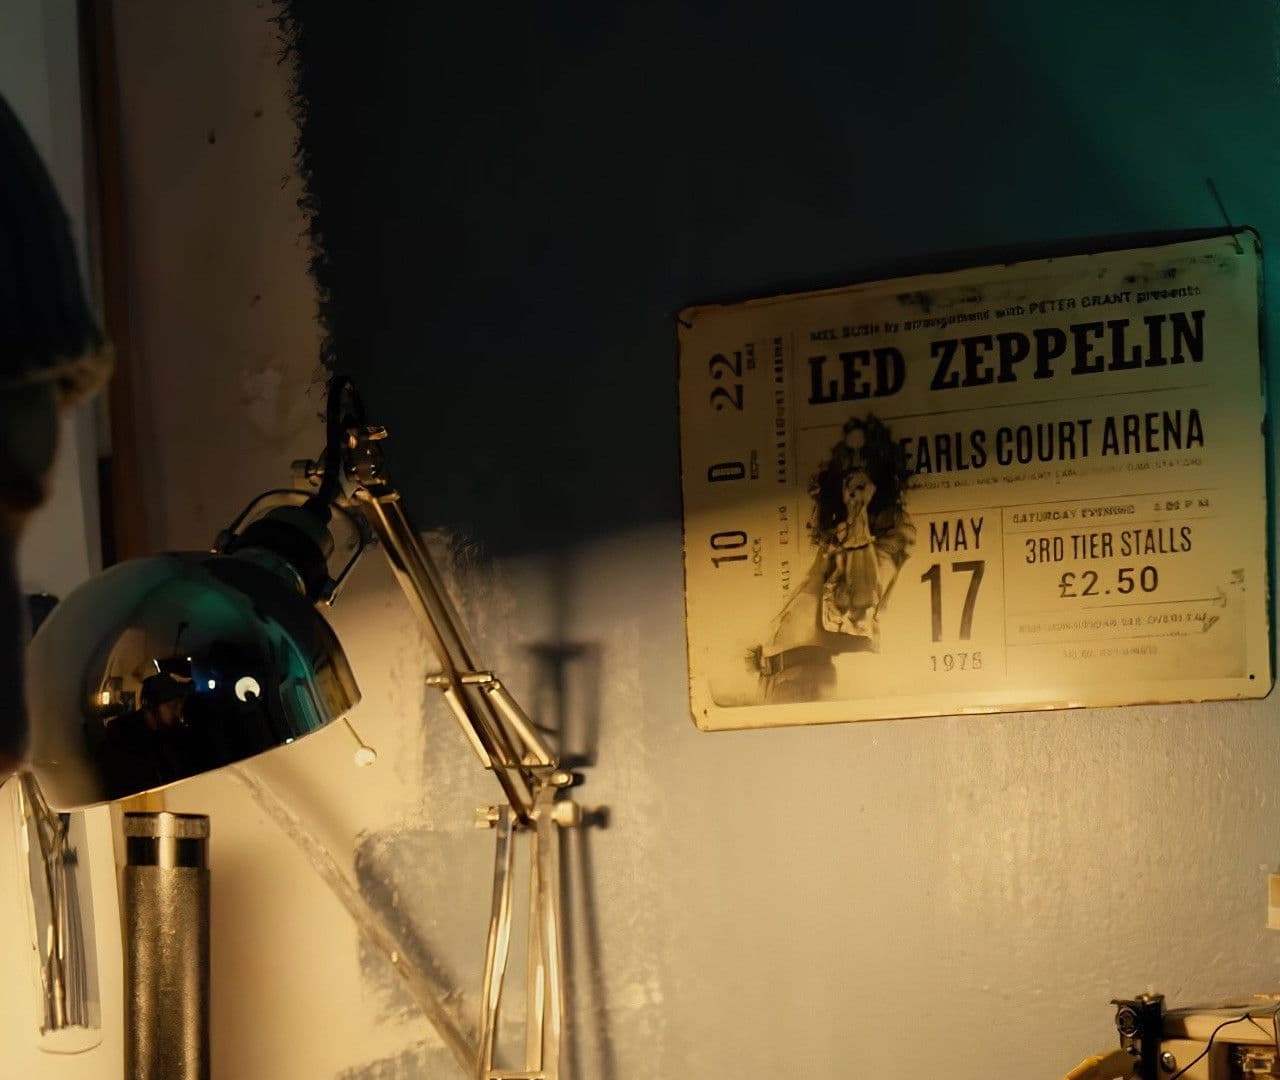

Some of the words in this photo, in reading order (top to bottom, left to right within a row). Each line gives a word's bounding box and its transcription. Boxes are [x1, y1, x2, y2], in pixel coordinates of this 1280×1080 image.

[1029, 298, 1076, 314] PETER
[1081, 291, 1132, 308] GRANT
[1136, 285, 1202, 304] presents
[807, 346, 907, 405] LED
[929, 310, 1208, 391] ZEPPELIN
[708, 351, 743, 411] 22
[901, 428, 988, 478] EARLS
[996, 418, 1092, 468] COURT
[1101, 408, 1204, 457] ARENA
[708, 461, 745, 482] D
[710, 531, 748, 568] 10
[929, 516, 984, 553] MAY
[1025, 536, 1064, 563] 3RD
[1071, 532, 1114, 560] TIER
[1121, 526, 1192, 557] STALLS
[1058, 566, 1159, 598] £2.50
[920, 560, 986, 643] 17
[929, 653, 983, 673] 1975
